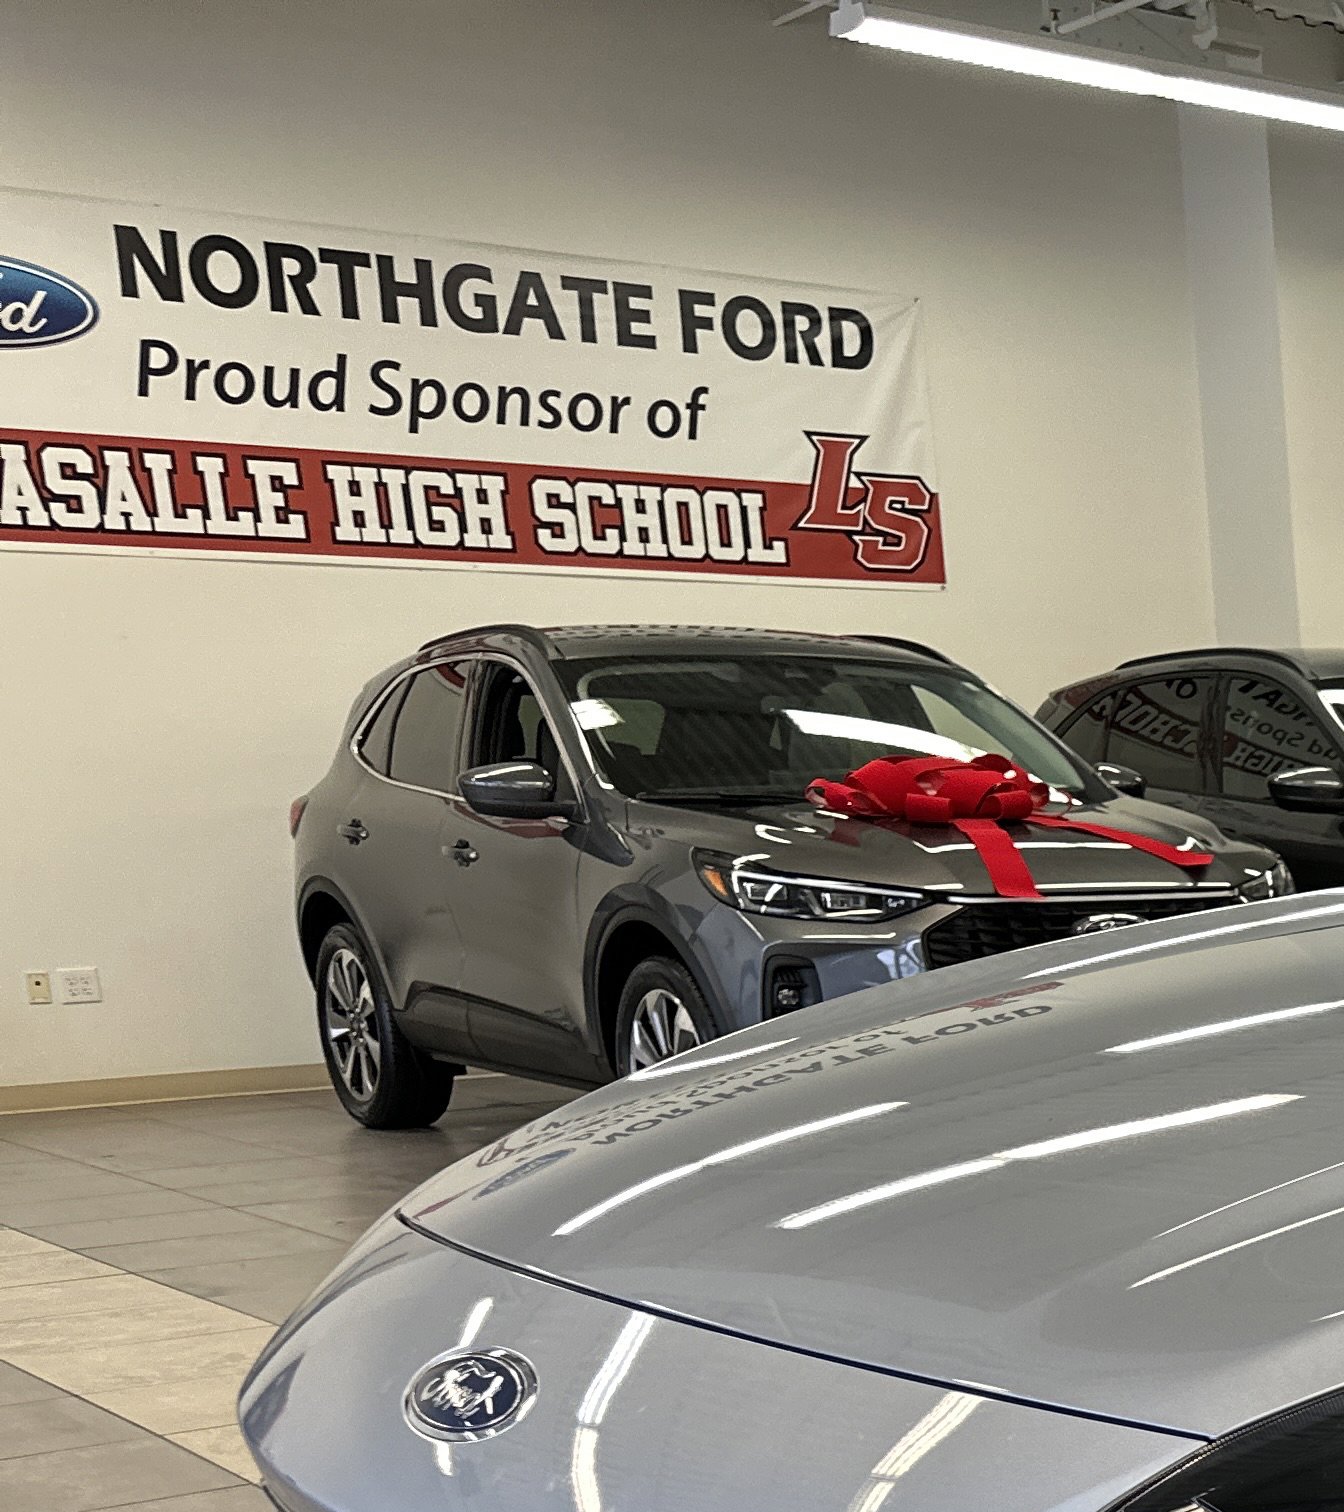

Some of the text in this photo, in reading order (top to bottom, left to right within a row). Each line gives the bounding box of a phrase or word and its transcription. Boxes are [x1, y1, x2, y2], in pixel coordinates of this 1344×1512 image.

[112, 224, 658, 350] NORTHGATE
[677, 288, 875, 370] FORD
[137, 338, 710, 441] Proud Sponsor of
[325, 464, 513, 549] HIGH
[531, 478, 788, 564] SCHOOL
[790, 430, 933, 573] LS
